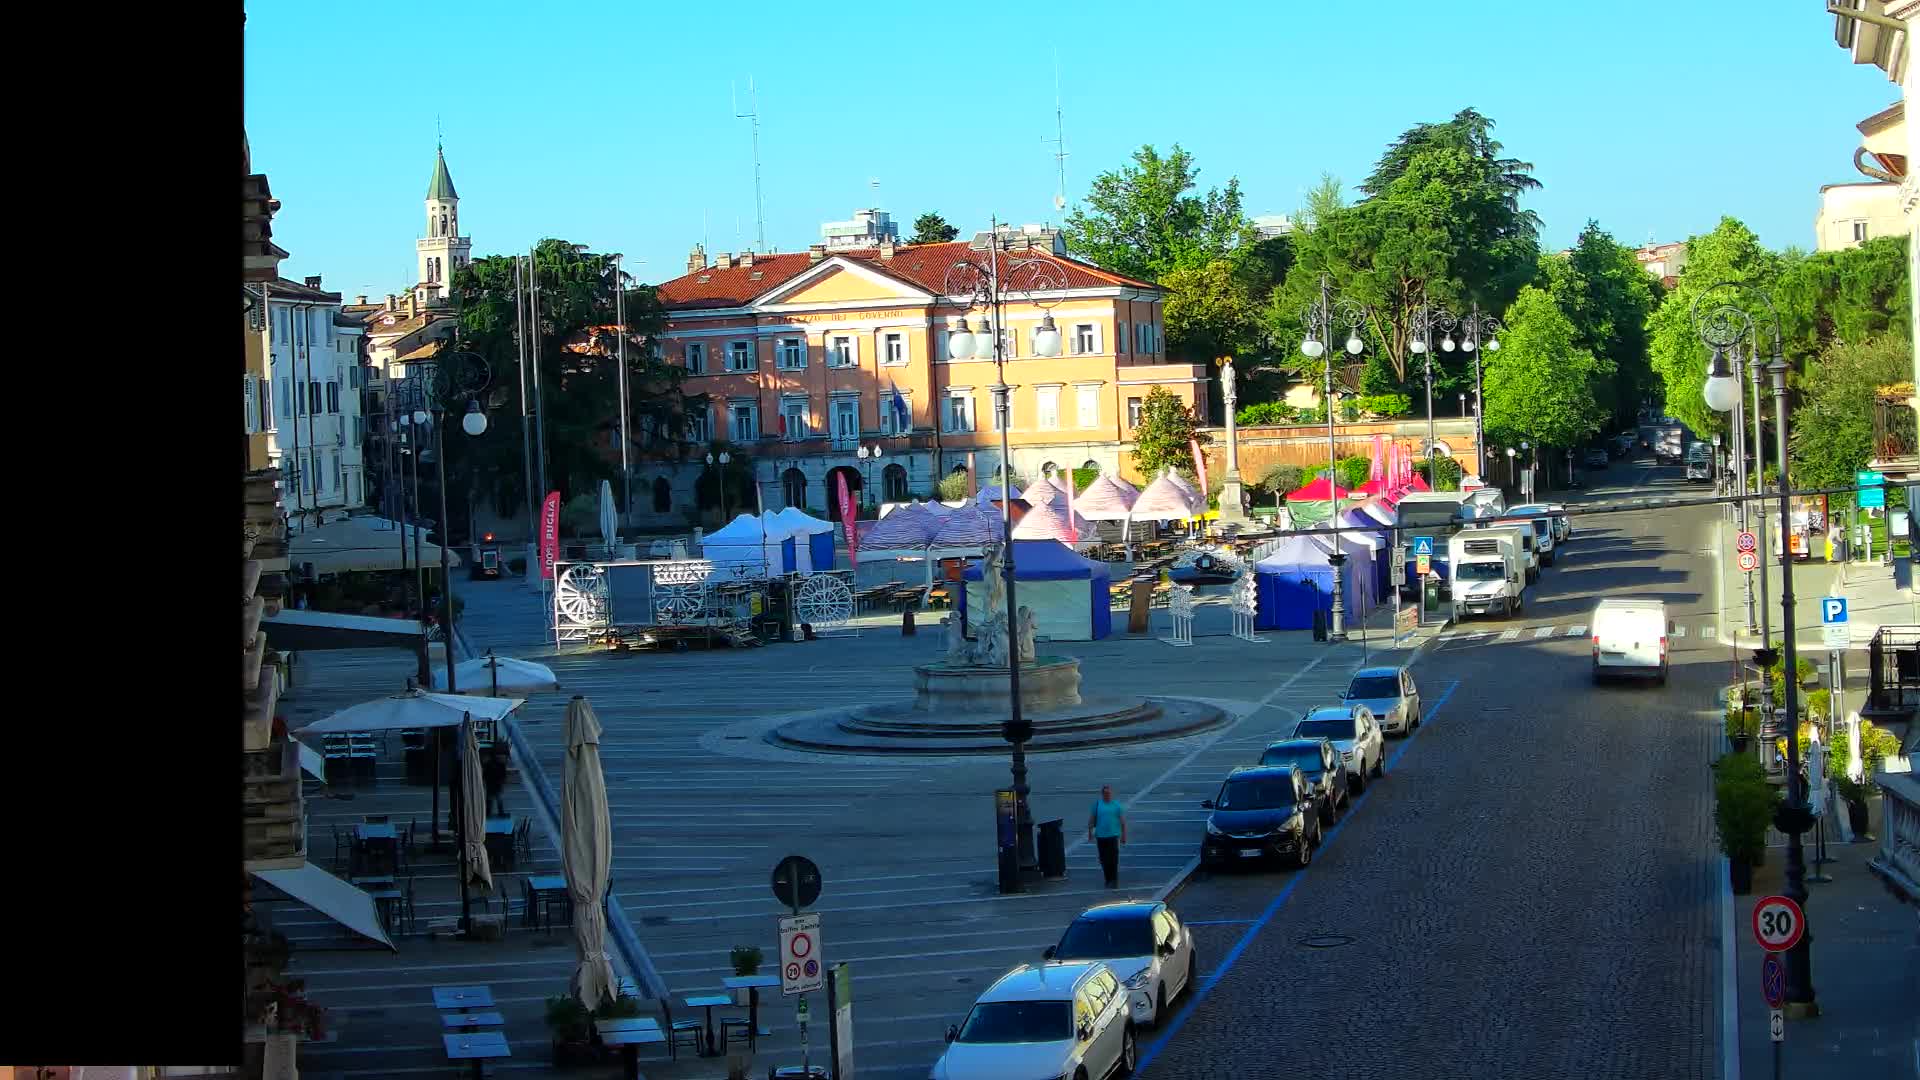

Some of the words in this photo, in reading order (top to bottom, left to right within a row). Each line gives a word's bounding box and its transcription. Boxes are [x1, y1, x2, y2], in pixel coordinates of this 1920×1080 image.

[545, 500, 555, 540] PUGLIA
[545, 544, 554, 570] 100%
[1827, 600, 1842, 621] P
[1762, 910, 1792, 937] 30
[789, 967, 798, 977] 20
